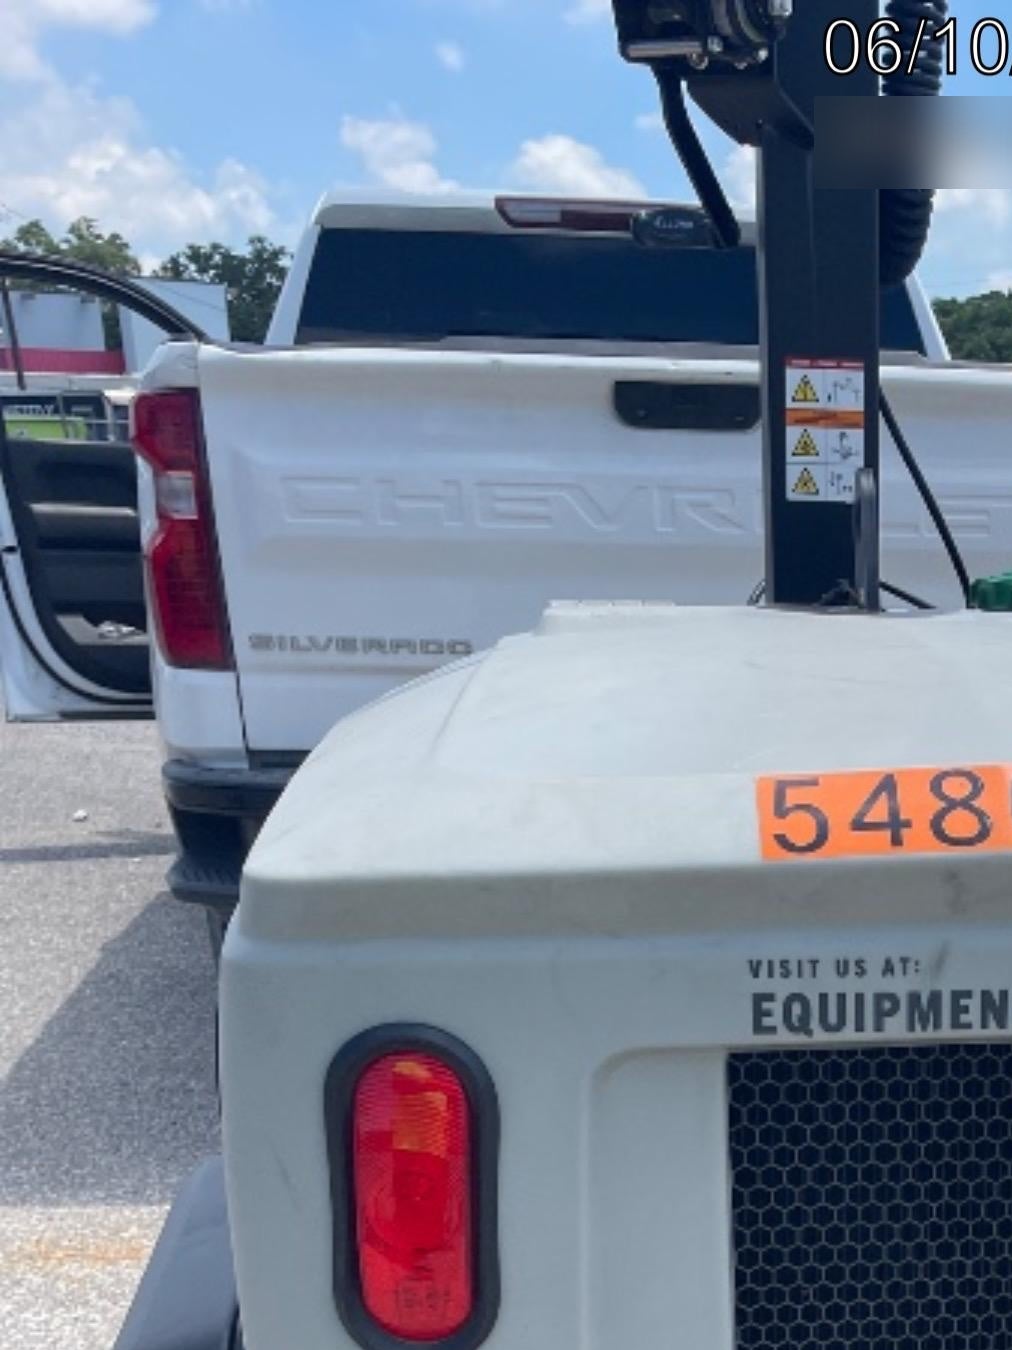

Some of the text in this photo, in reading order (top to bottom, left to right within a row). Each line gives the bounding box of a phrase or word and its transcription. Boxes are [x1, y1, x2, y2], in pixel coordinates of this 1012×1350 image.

[249, 633, 473, 655] SILVERADO
[748, 956, 921, 979] VISIT US AT:
